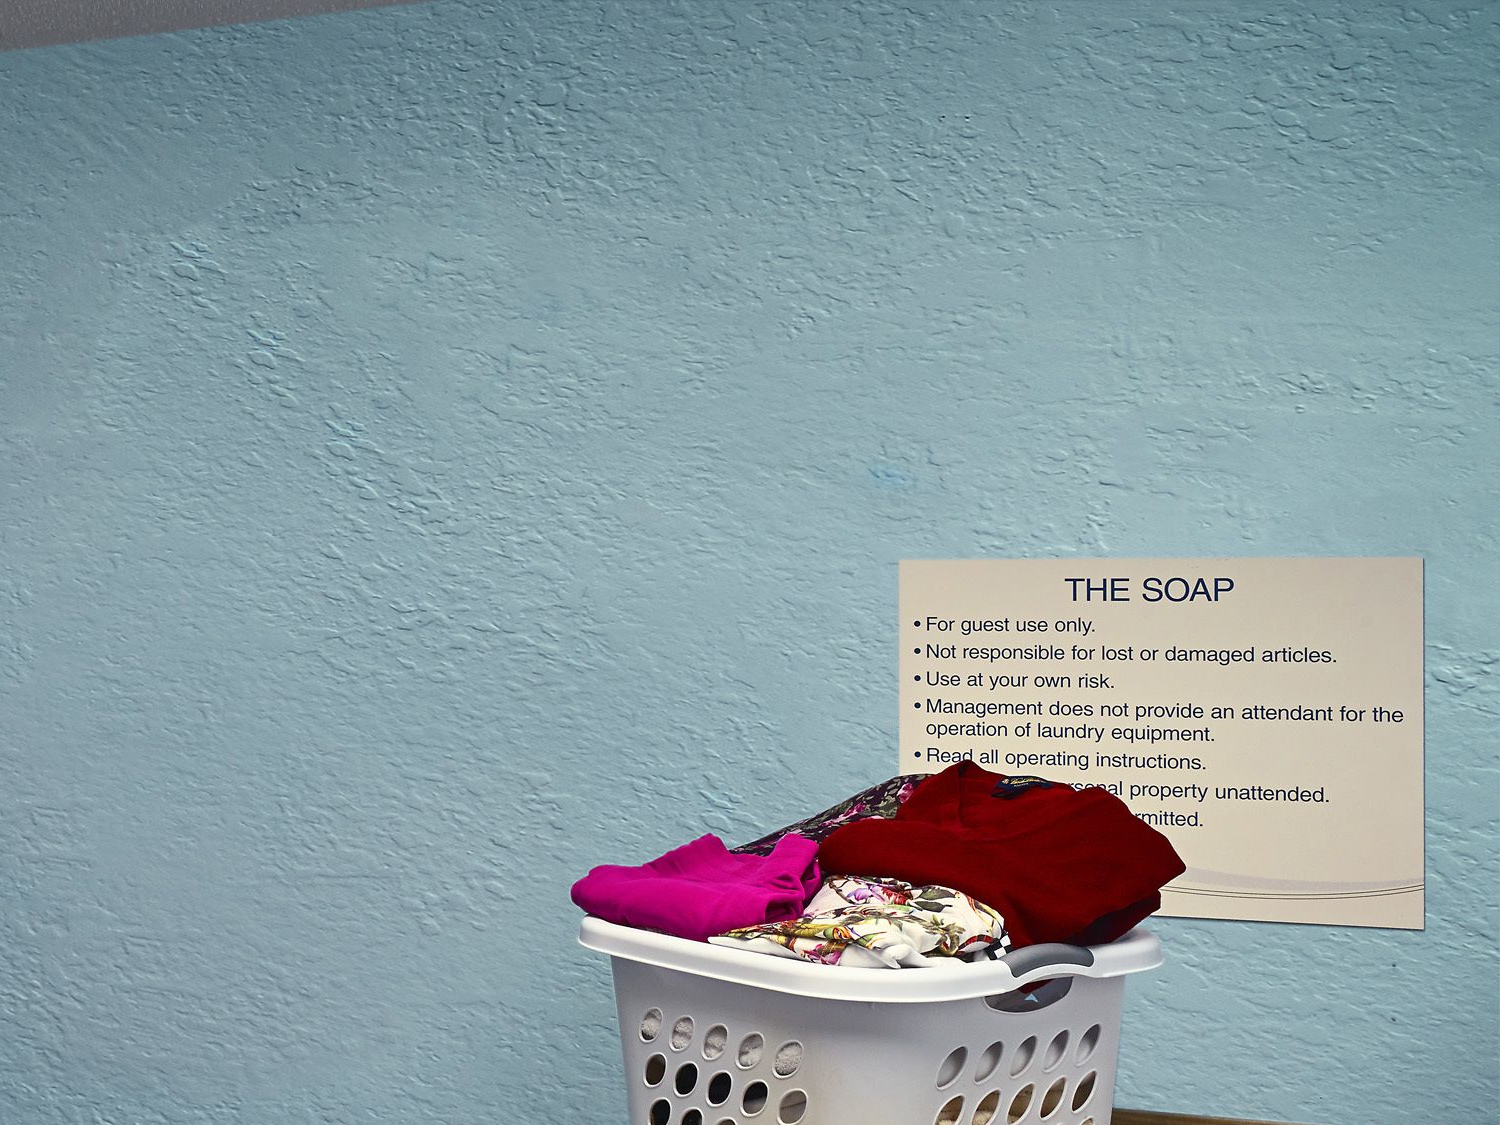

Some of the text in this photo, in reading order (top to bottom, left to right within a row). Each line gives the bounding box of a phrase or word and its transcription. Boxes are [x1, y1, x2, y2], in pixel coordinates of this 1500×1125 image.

[1064, 577, 1235, 603] THE SOAP
[926, 616, 1096, 637] For guest use only.
[926, 643, 1337, 666] Not responsible for lost or damaged articles.
[926, 670, 1115, 691] Use at your own risk.
[926, 698, 1404, 723] Management does not provide an attendant for the
[925, 721, 1215, 745] operation of laundry equipment.
[926, 747, 1207, 771] Read all operating instructions.
[1130, 783, 1209, 803] property
[1215, 785, 1330, 803] unattended.
[1134, 810, 1204, 828] rmitted.
